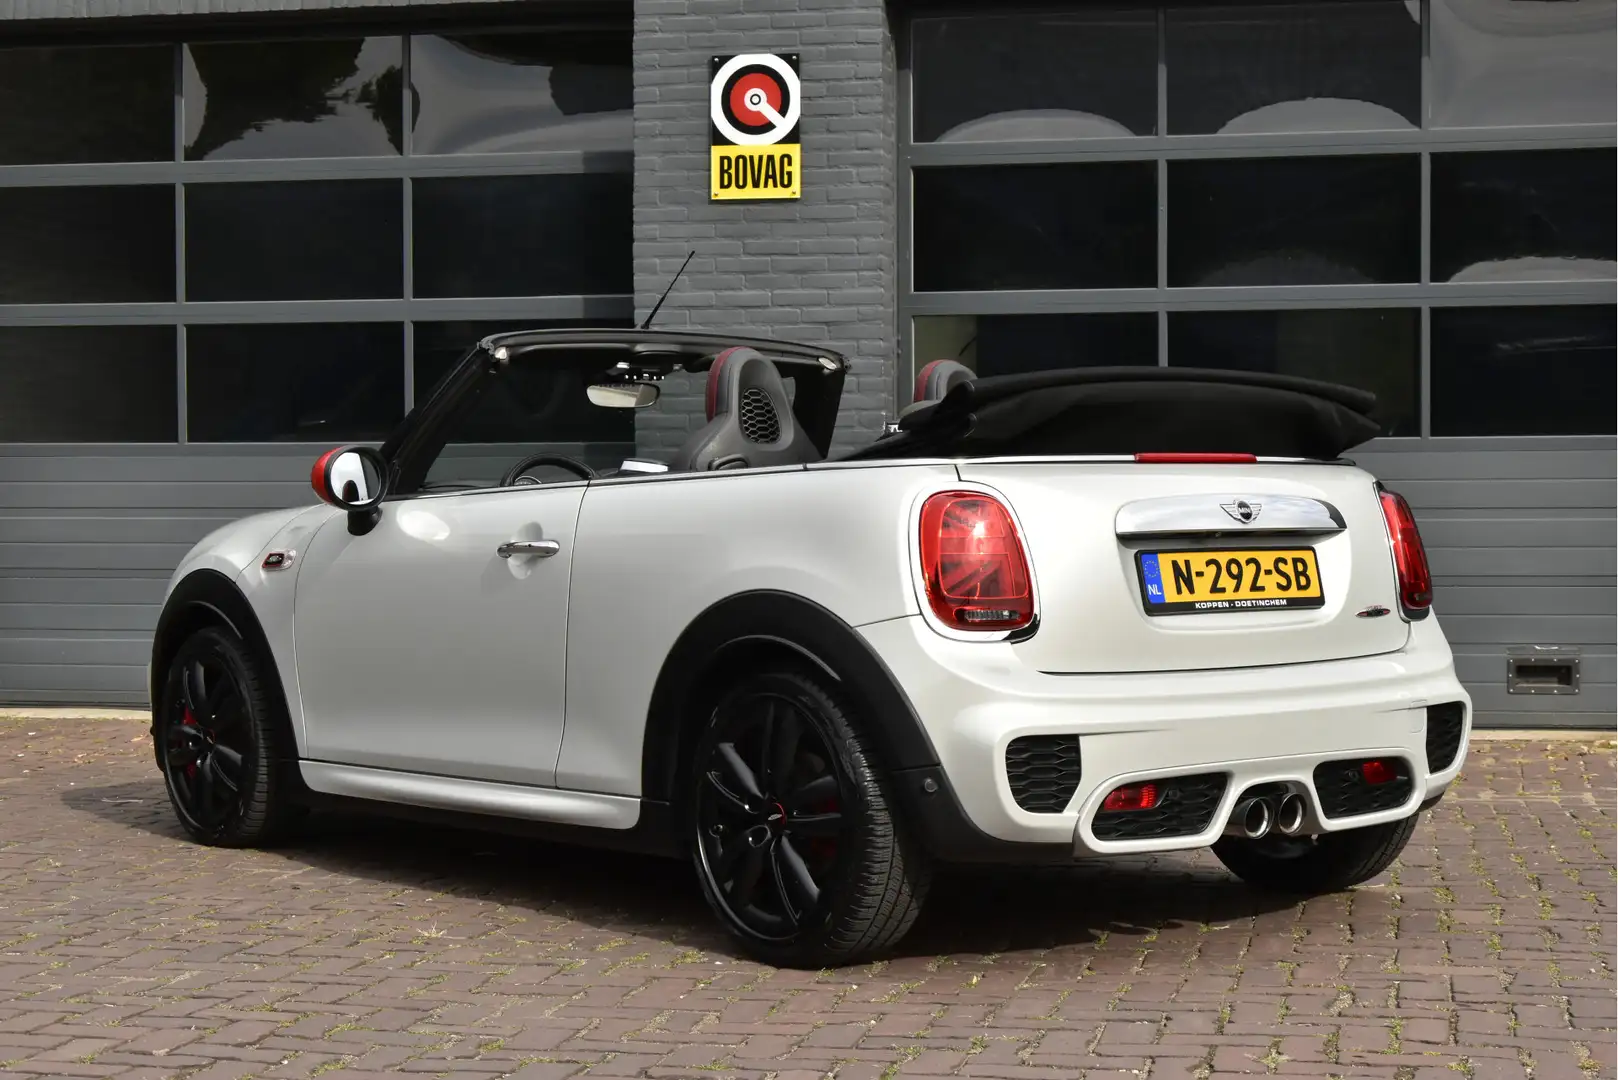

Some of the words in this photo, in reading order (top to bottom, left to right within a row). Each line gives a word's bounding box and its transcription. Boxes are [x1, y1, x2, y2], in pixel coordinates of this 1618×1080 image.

[719, 153, 793, 190] BOVAG
[1171, 556, 1312, 595] N-292-SB
[1147, 584, 1162, 596] NL
[1195, 601, 1230, 609] KOPPEN
[1235, 599, 1287, 607] DOETINCHEM
